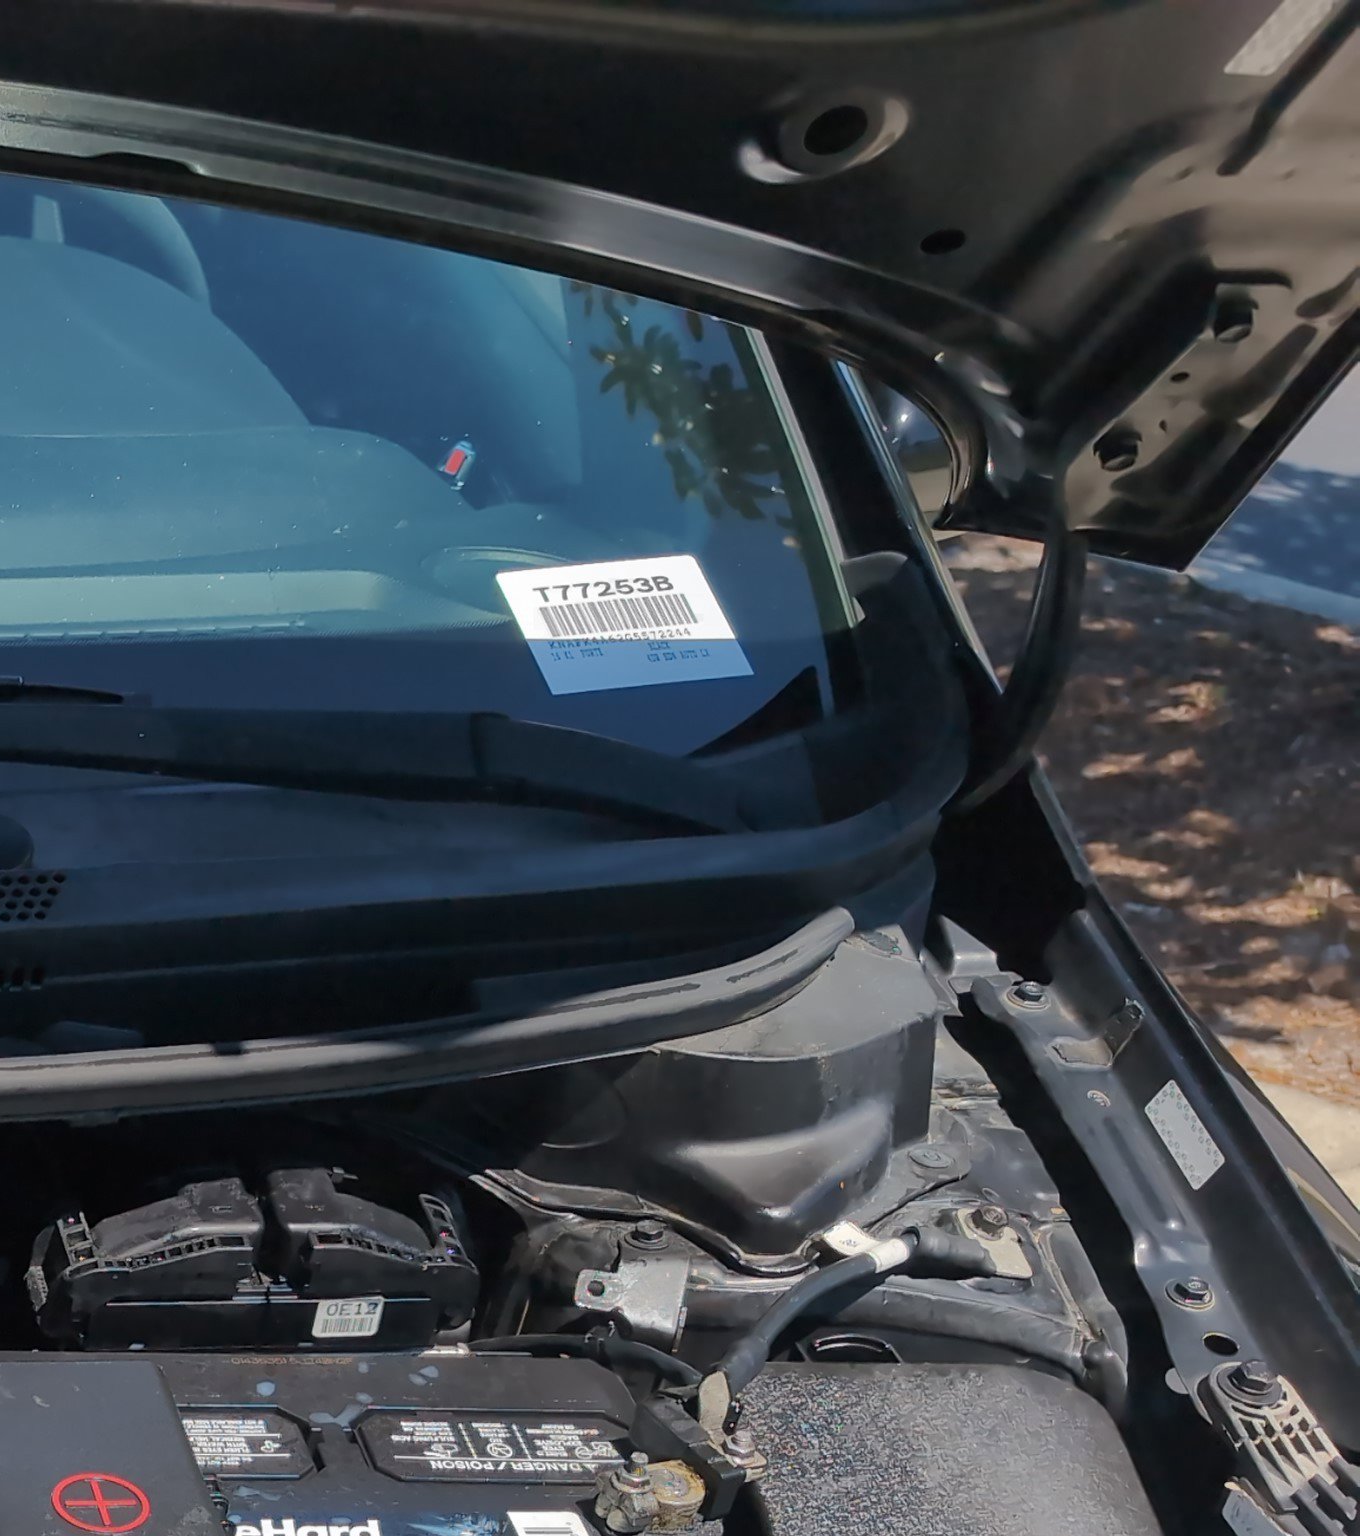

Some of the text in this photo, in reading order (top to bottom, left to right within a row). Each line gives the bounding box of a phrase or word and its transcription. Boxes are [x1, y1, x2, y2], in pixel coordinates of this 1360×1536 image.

[533, 575, 674, 603] T77253B
[429, 1460, 495, 1470] POISON
[509, 1461, 584, 1471] DANGER
